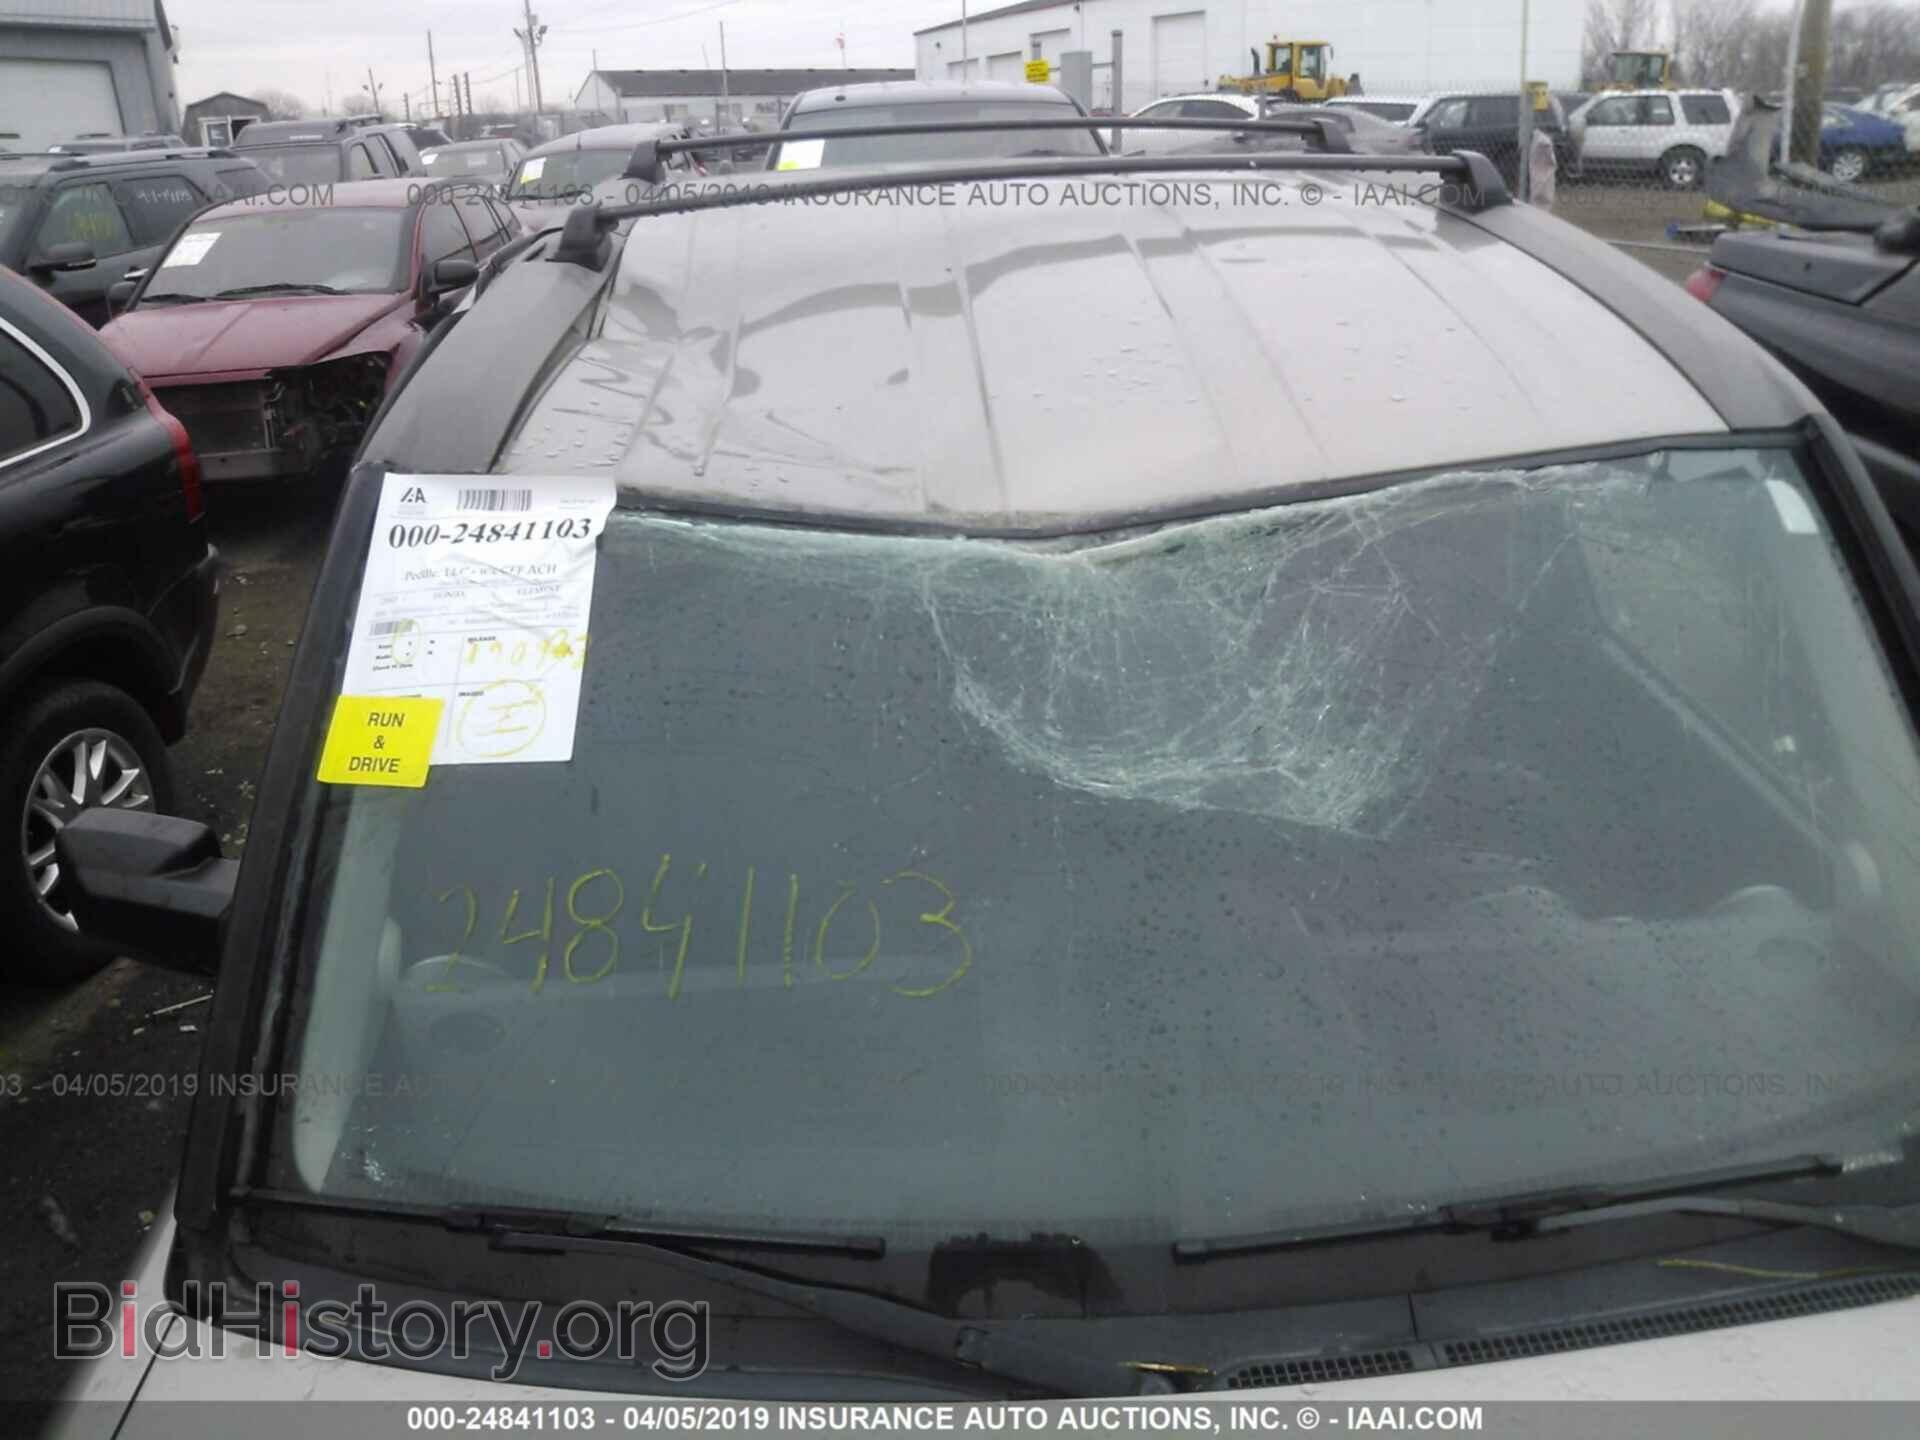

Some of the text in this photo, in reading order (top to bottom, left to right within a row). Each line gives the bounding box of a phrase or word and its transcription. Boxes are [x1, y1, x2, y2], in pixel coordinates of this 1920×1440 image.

[388, 517, 592, 549] 000-24841103
[367, 711, 406, 728] RUN
[373, 734, 385, 750] &
[348, 756, 400, 774] DRIVE
[426, 853, 973, 1000] 24841103
